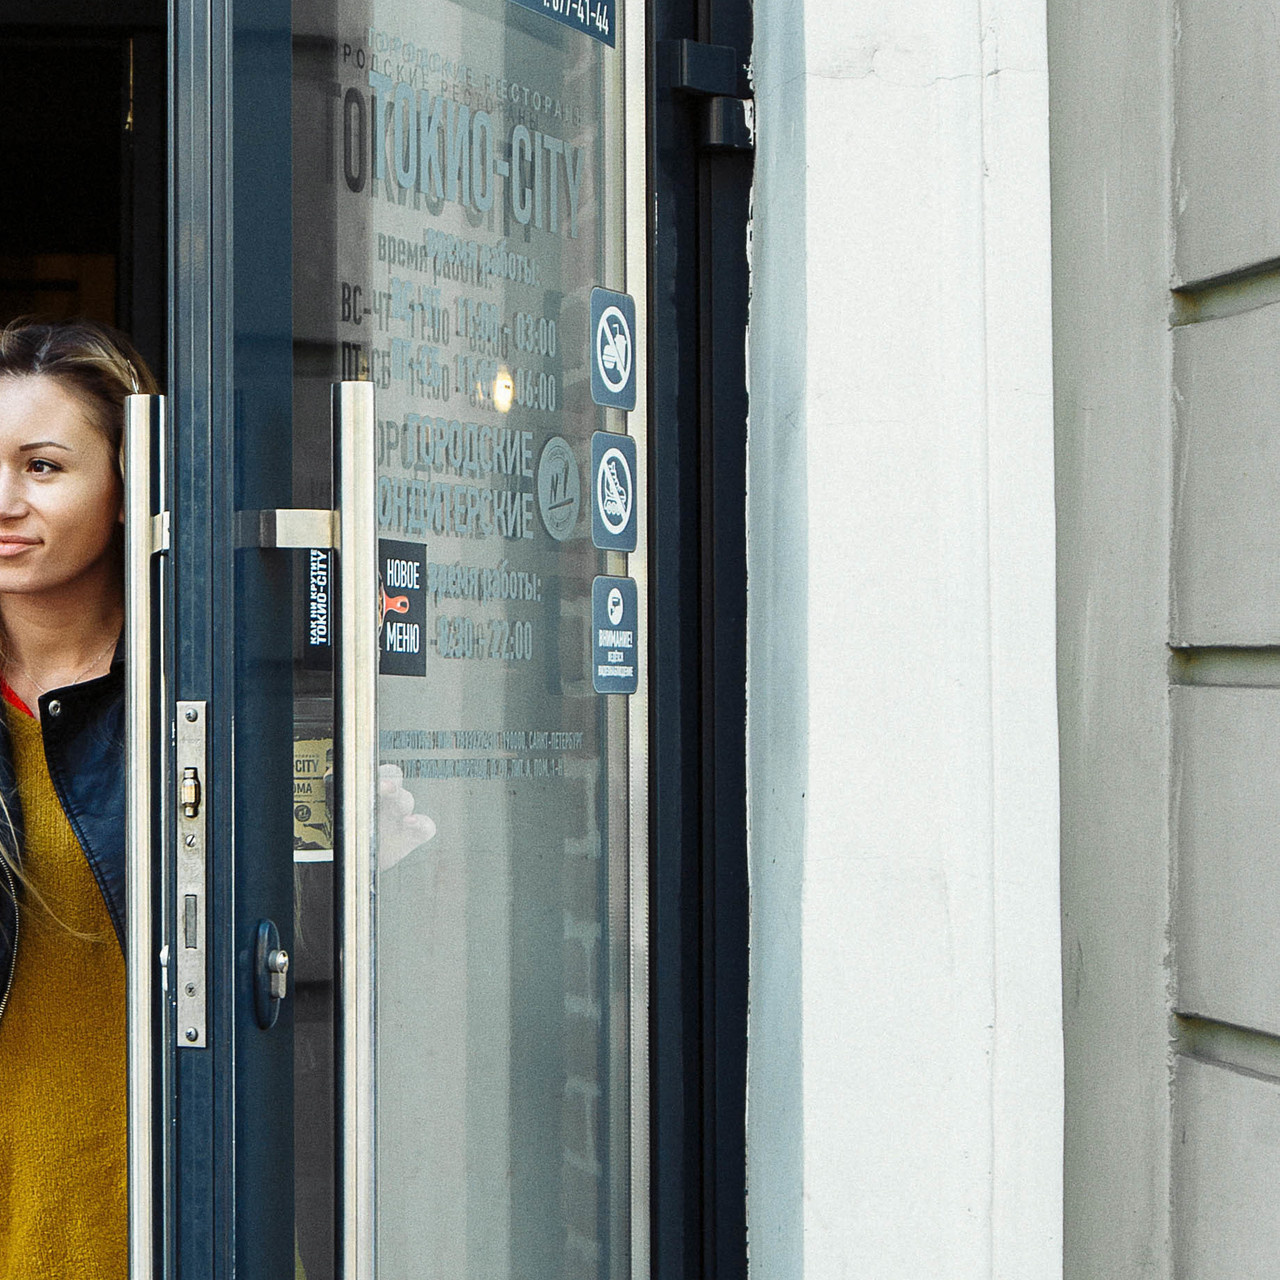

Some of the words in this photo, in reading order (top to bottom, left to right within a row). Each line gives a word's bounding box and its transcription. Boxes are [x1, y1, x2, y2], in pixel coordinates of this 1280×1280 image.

[378, 475, 534, 540] ОНДИТЕРСКИЕ
[386, 558, 420, 590] НОВОЕ
[309, 620, 318, 645] КАК
[386, 621, 420, 654] МЕНЮ
